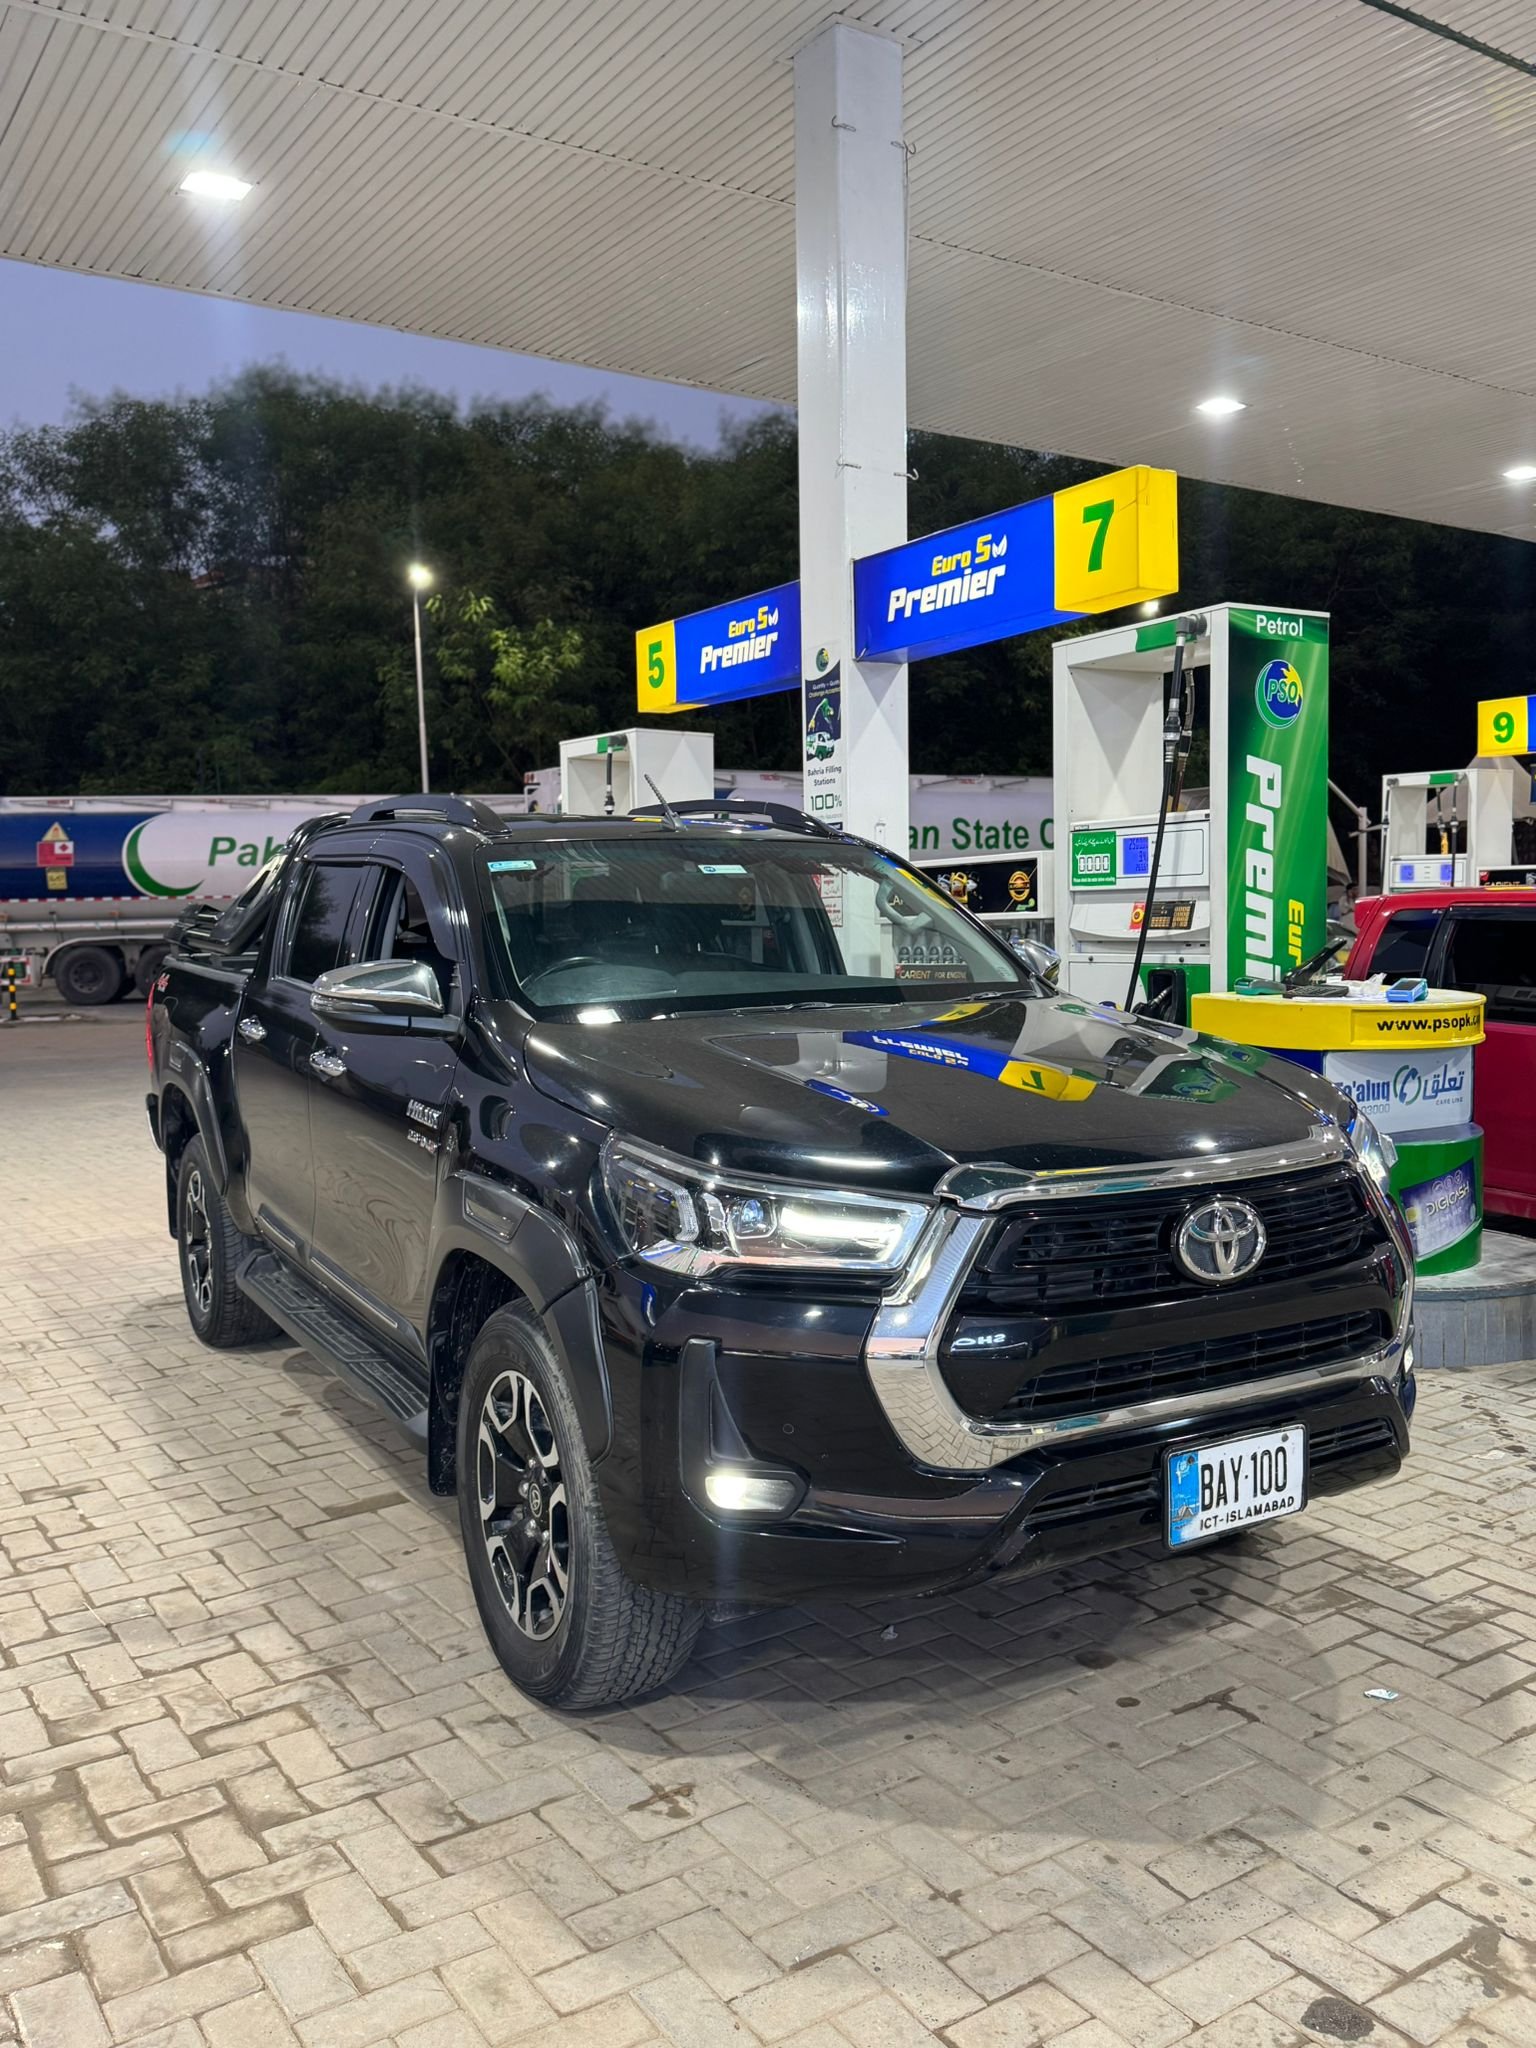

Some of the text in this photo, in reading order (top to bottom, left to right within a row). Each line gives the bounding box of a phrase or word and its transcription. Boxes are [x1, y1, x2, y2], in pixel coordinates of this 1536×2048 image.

[1082, 499, 1115, 573] 7
[931, 534, 992, 577] Euro 5
[887, 564, 1006, 623] Premier
[728, 606, 769, 639] Euro 5
[1256, 614, 1303, 637] Petrol
[648, 640, 665, 689] 5
[700, 632, 779, 675] Premier
[1266, 678, 1299, 704] PSO
[1493, 712, 1515, 743] 9
[810, 793, 843, 811] 100%
[951, 817, 1030, 850] State
[1422, 1064, 1465, 1100] تعلق
[1425, 1181, 1470, 1216] DIGICASH
[1200, 1496, 1295, 1530] ICT-ISLAMABAD
